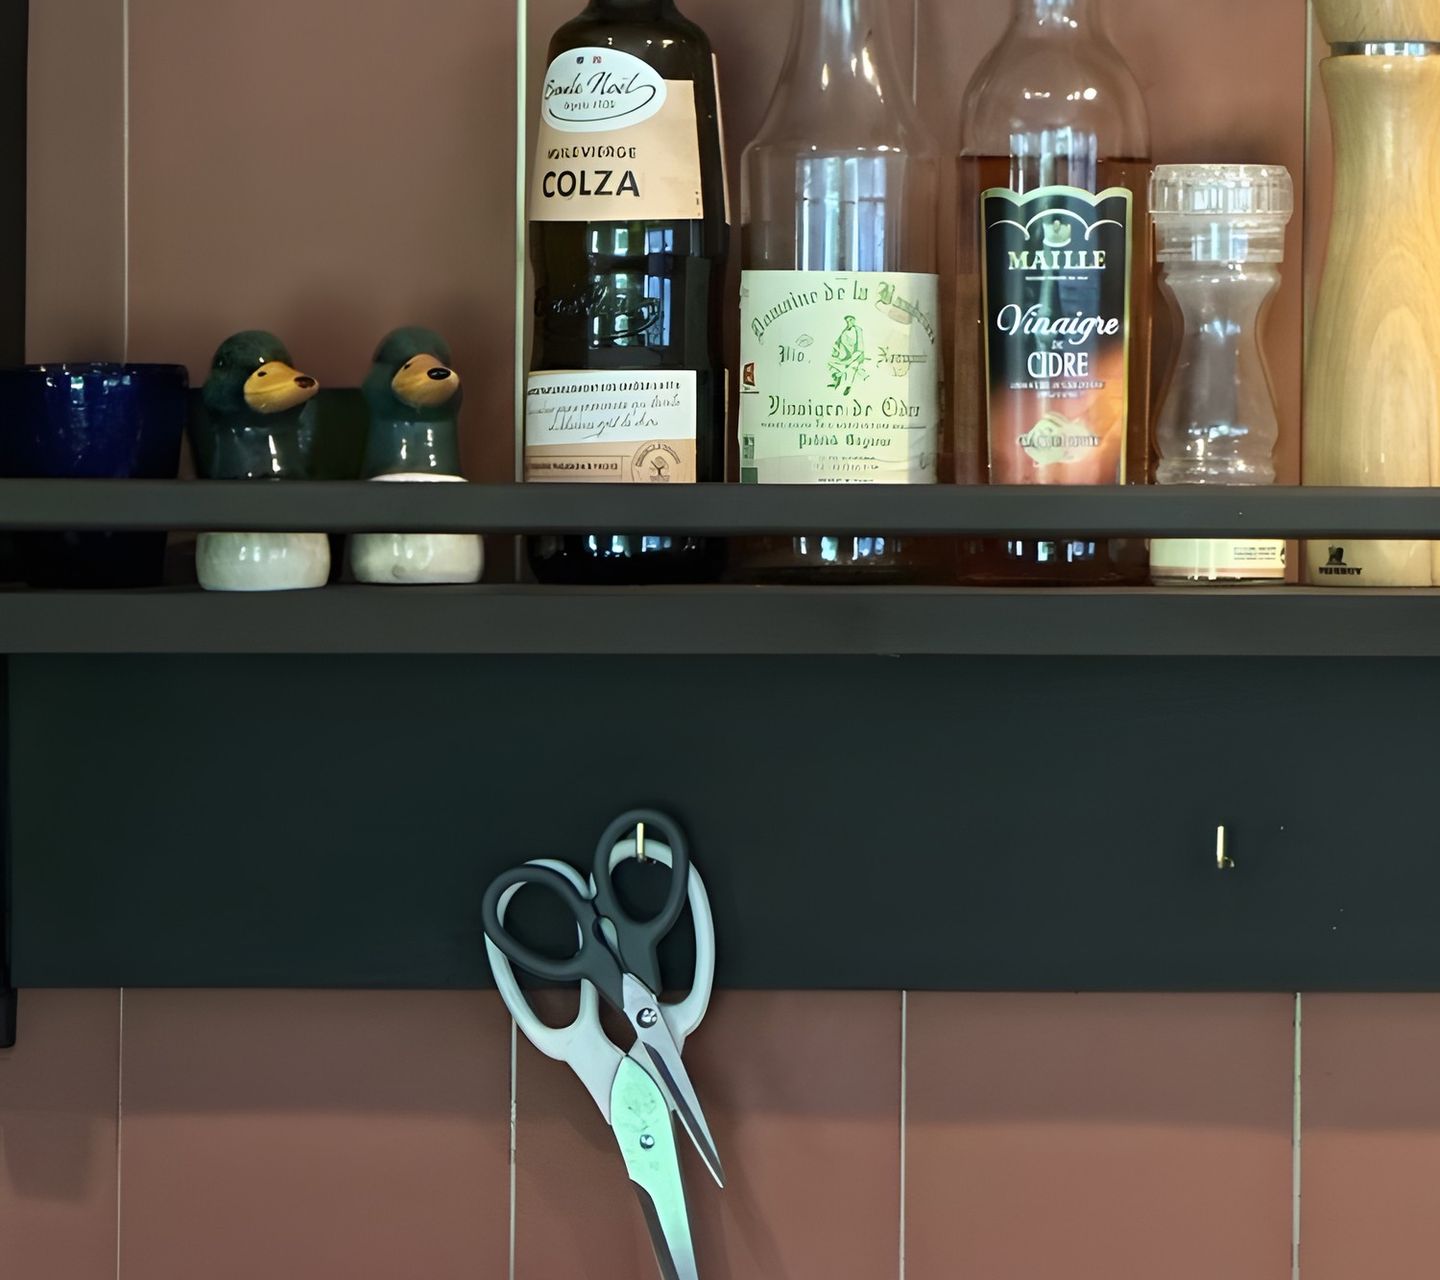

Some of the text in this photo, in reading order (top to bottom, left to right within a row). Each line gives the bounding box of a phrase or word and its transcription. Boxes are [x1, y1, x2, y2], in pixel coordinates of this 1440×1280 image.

[542, 170, 640, 198] COLZA
[1008, 250, 1106, 270] MAILLE
[996, 303, 1119, 345] Vinaigre
[1027, 352, 1089, 378] CIDRE
